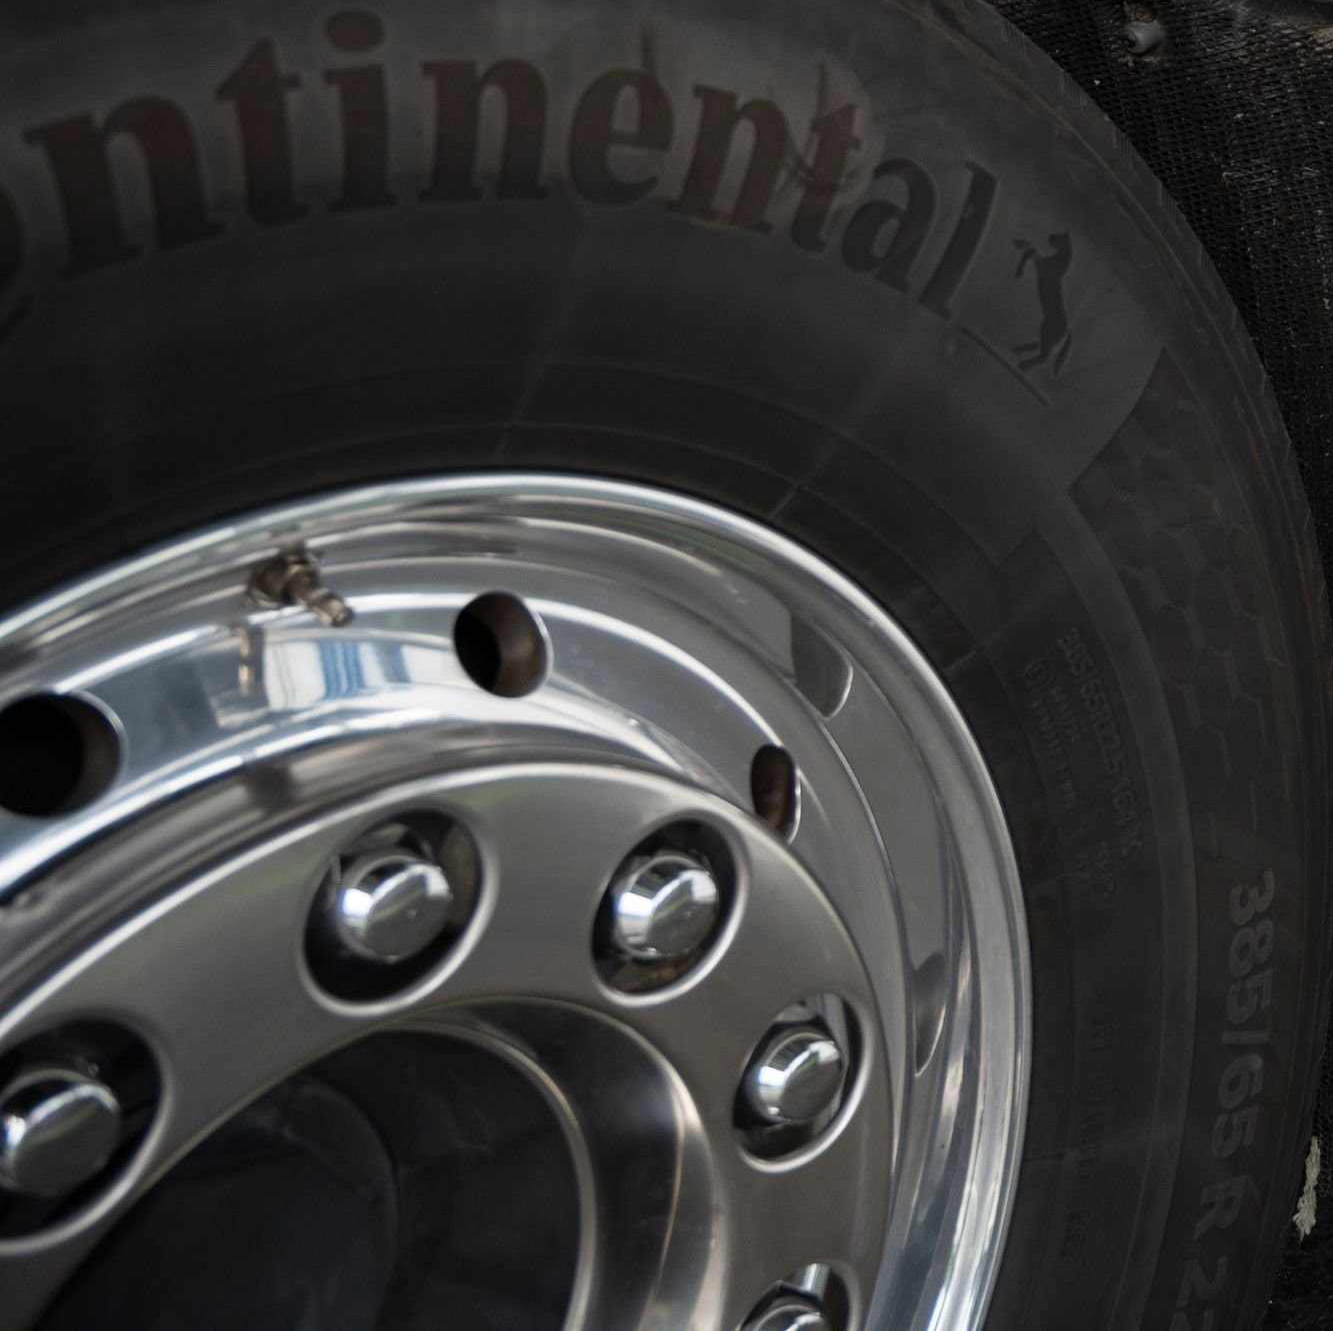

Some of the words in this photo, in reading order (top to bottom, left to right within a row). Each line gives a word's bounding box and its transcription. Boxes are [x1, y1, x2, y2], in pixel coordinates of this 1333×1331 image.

[0, 10, 1000, 346] ntinental
[1193, 1174, 1249, 1241] R
[1168, 1255, 1229, 1331] 2
